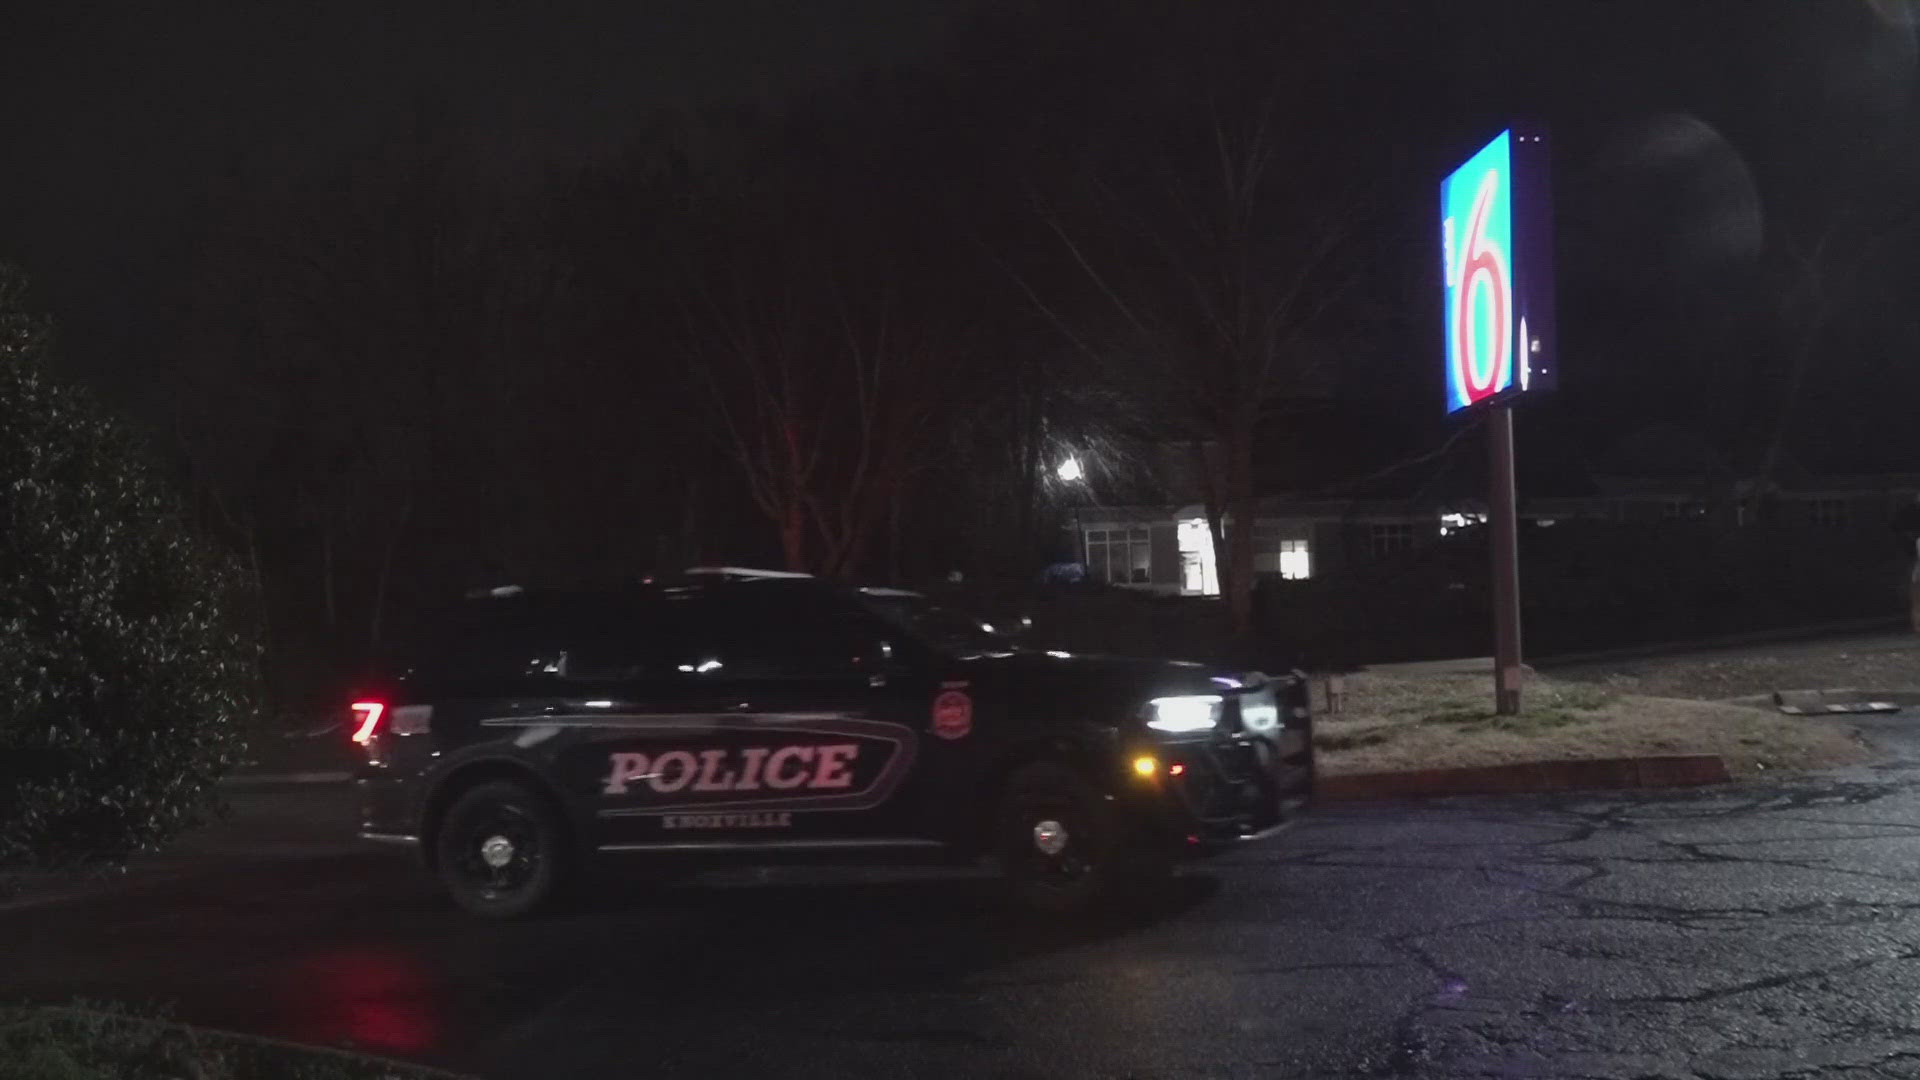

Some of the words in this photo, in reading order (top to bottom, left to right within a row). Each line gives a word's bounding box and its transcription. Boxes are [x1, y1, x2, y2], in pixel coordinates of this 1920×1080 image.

[1454, 167, 1513, 406] 6
[602, 744, 859, 795] POLICE
[661, 812, 793, 829] KNOXVILLE
